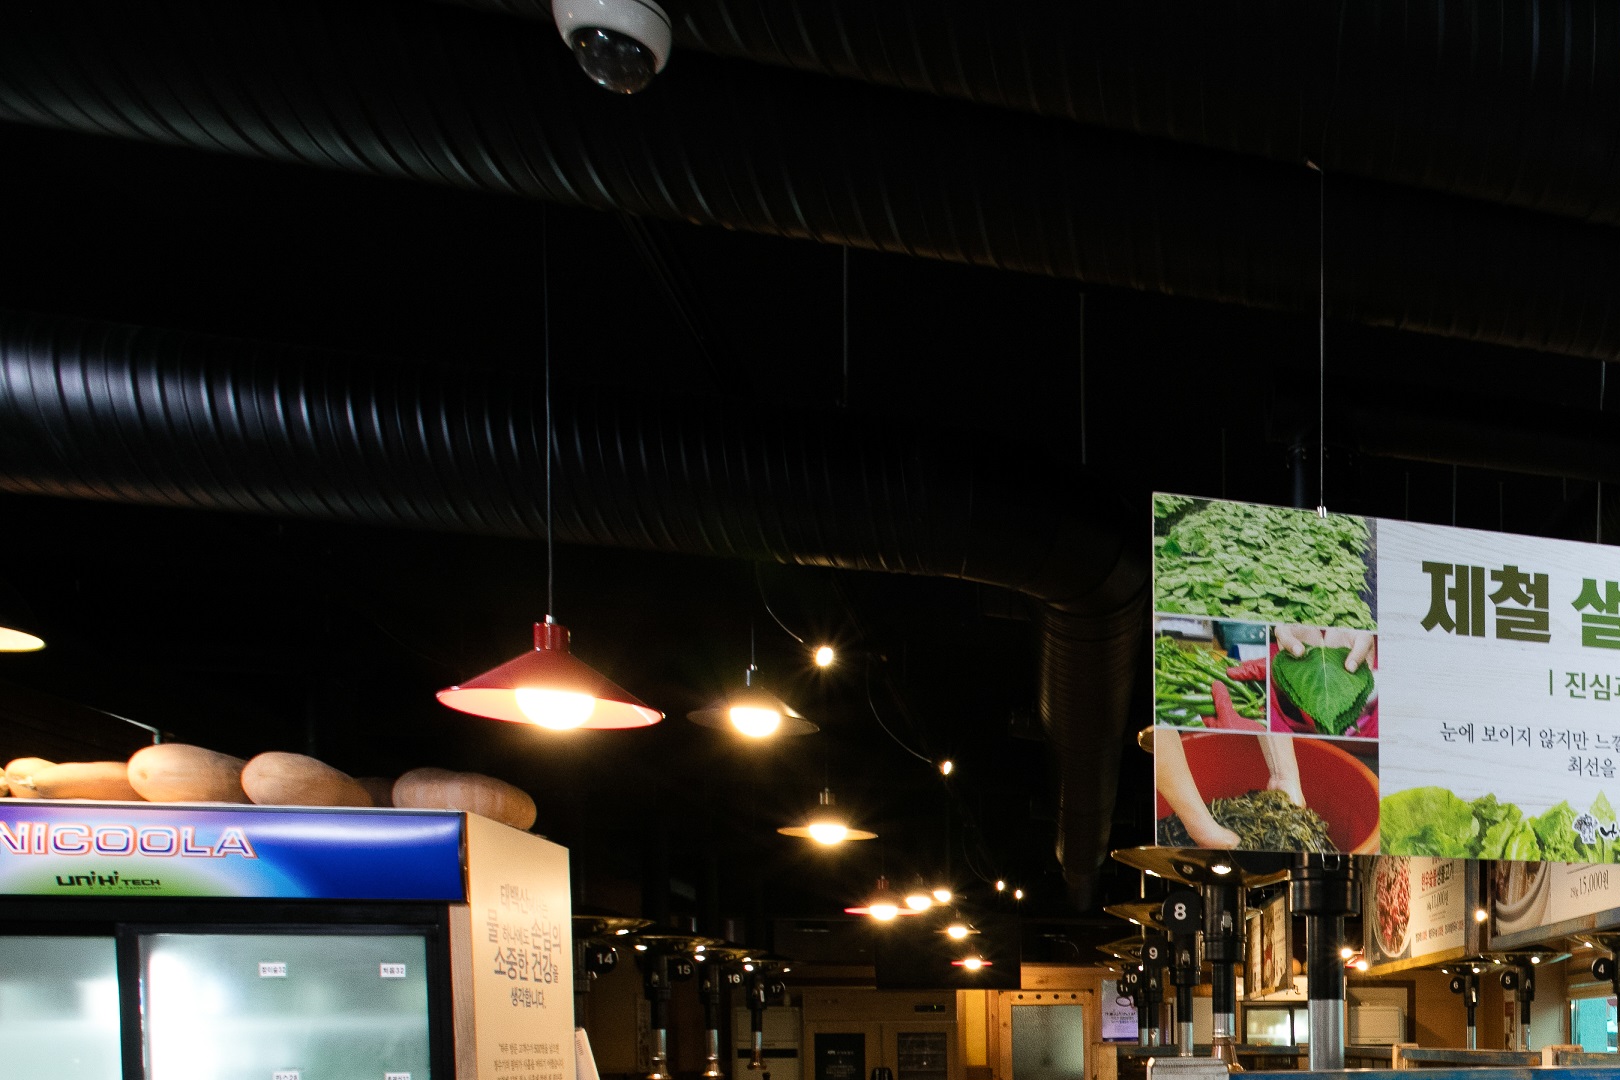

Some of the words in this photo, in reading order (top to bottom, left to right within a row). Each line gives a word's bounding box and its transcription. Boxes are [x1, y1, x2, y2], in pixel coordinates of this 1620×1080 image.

[1420, 560, 1551, 643] 제철
[1440, 722, 1474, 744] 눈에
[1482, 725, 1531, 748] 보이지
[1539, 728, 1589, 751] 않지만
[1568, 756, 1616, 779] 최선을
[1173, 902, 1187, 921] 8
[531, 919, 561, 954] 손님의
[596, 953, 613, 965] 14
[1149, 947, 1158, 960] 9
[494, 946, 528, 981] 소중한
[677, 964, 691, 975] 15
[1598, 964, 1605, 974] 4
[727, 974, 740, 983] 16
[1126, 973, 1138, 984] 10
[771, 984, 782, 993] 17
[511, 986, 546, 1009] 생각합니다.
